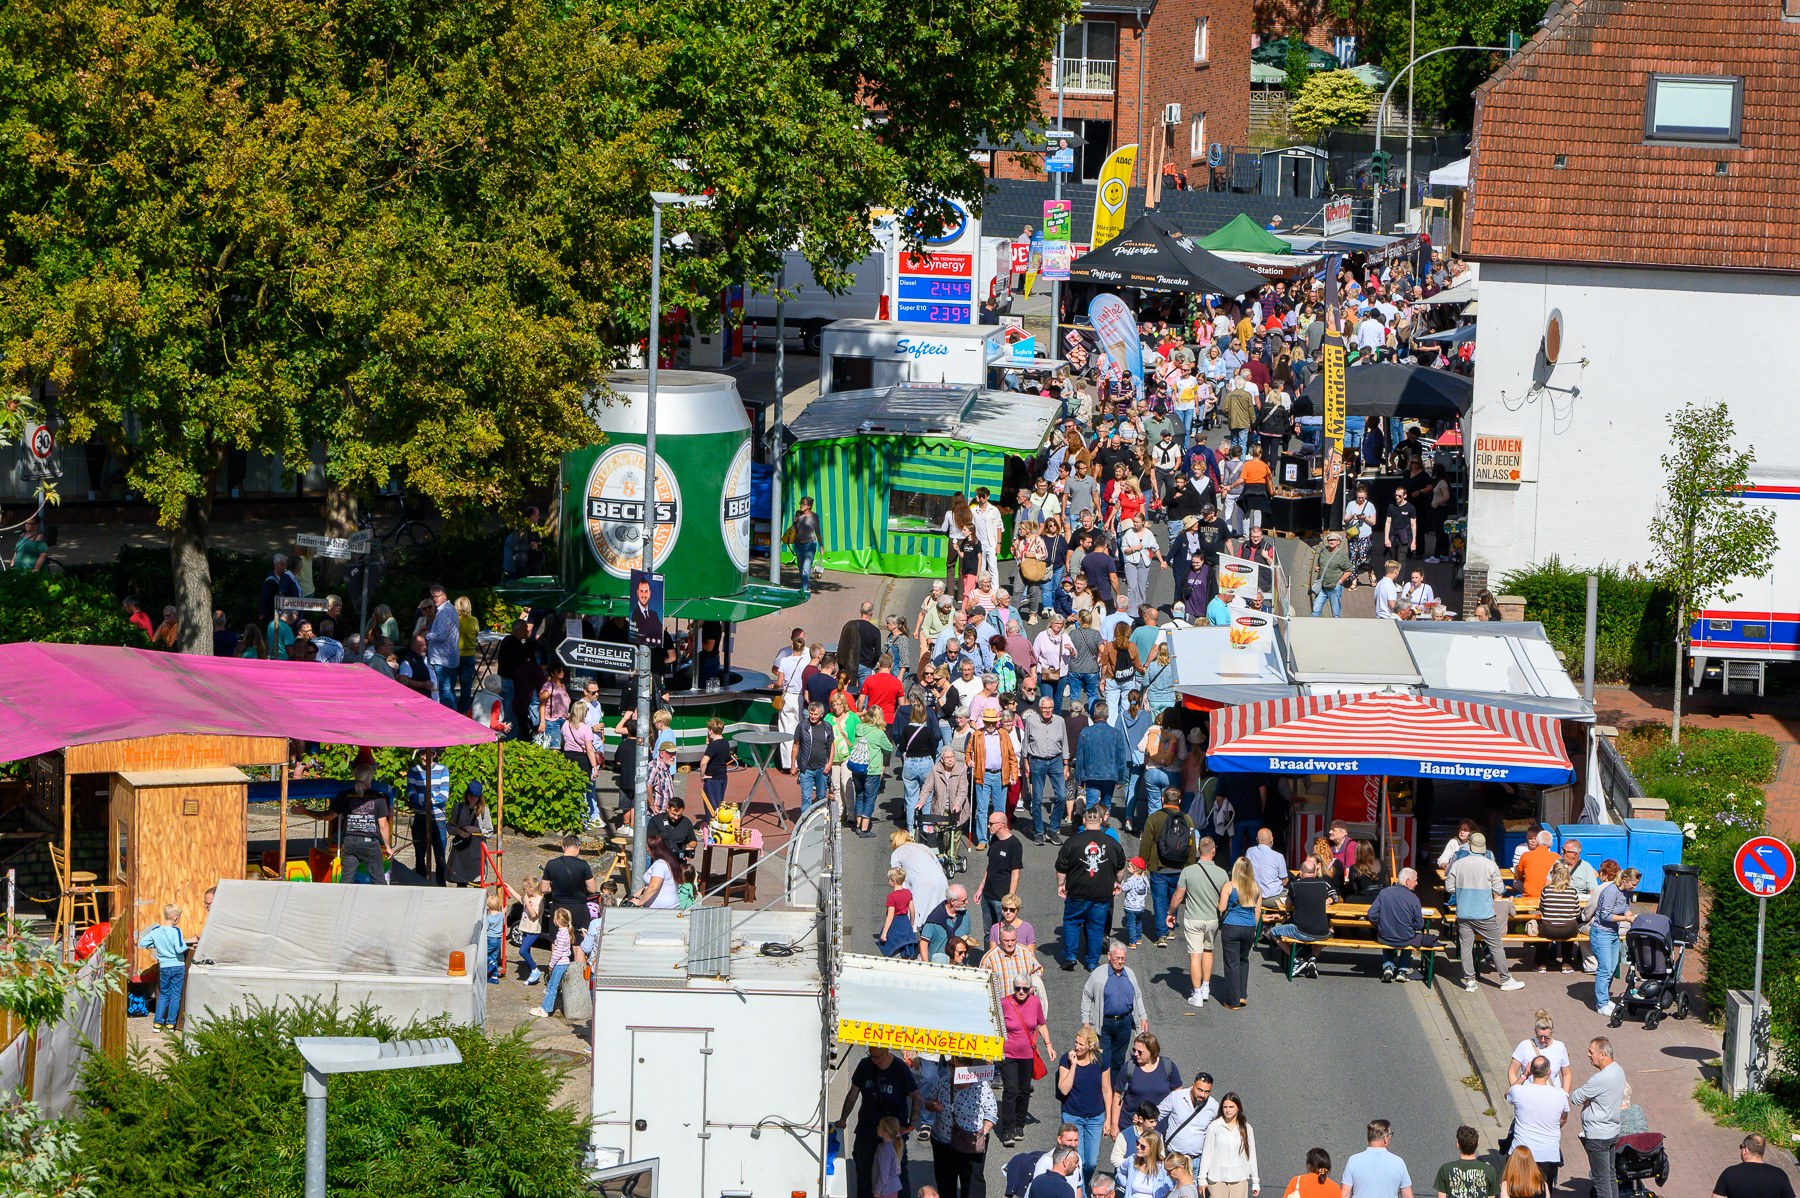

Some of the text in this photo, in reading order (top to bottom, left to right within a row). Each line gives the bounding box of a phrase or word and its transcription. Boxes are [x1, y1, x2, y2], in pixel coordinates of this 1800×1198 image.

[1115, 156, 1132, 166] ADAC
[1112, 246, 1159, 256] Poffertjes
[922, 258, 966, 272] Synergy
[1091, 268, 1122, 280] Poffertjes
[1156, 274, 1190, 286] Pancakes
[930, 281, 970, 296] 2.449
[930, 306, 970, 322] 2.399
[894, 338, 949, 358] Softeis
[1332, 350, 1345, 435] Mandeln
[36, 434, 50, 450] 30
[1477, 438, 1522, 452] BLUMEN
[32, 461, 52, 471] ZONE
[1476, 453, 1520, 466] FÜR JEDEN
[1476, 469, 1509, 480] ANLASS
[592, 500, 672, 520] BECK'S
[578, 643, 631, 660] FRISEUR
[124, 744, 224, 762] Fantasy Train
[1269, 758, 1359, 771] Braadworst
[1420, 762, 1509, 779] Hamburger
[864, 1028, 977, 1050] ENTENANGELN
[956, 1070, 994, 1081] Angelspiel
